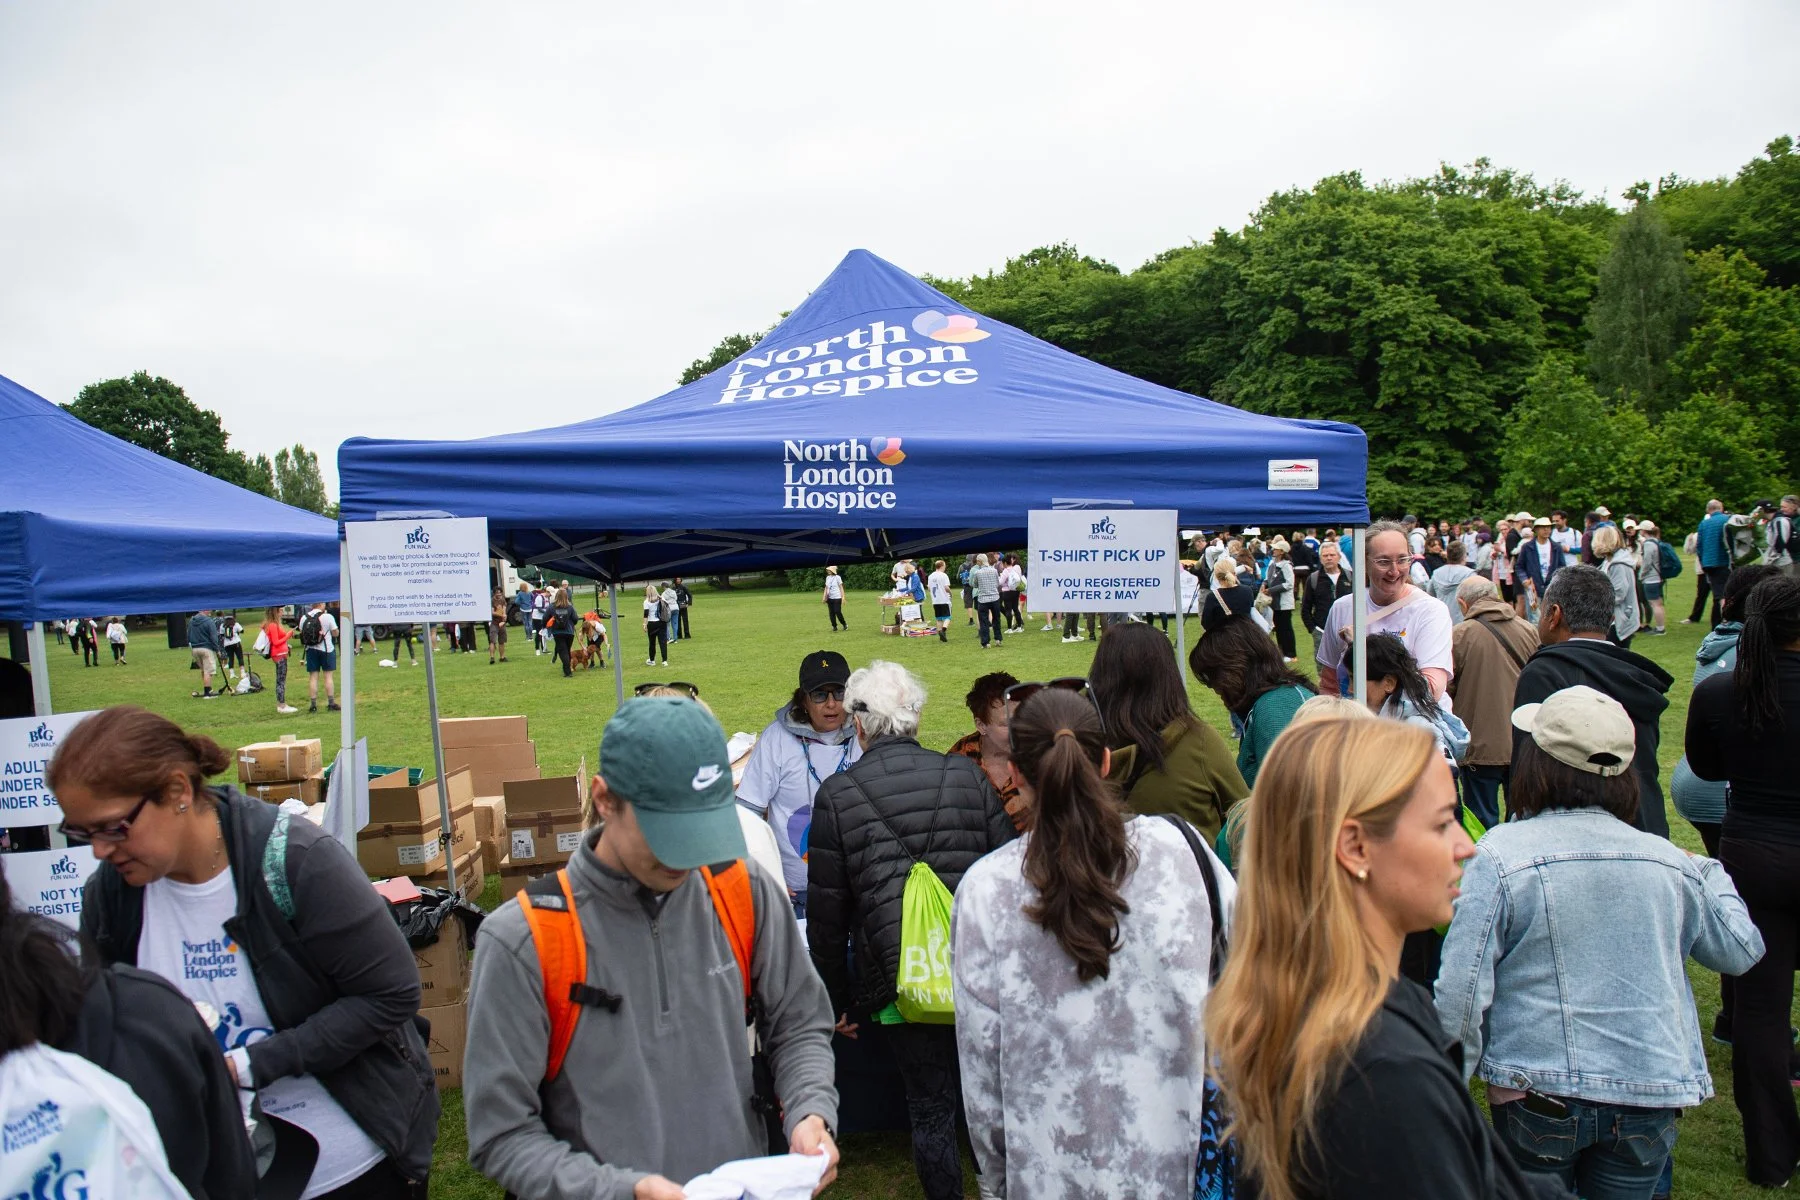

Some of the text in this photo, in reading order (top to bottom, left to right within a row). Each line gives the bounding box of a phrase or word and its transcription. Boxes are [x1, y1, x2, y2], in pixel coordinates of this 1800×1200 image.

[730, 321, 909, 375] North
[722, 345, 970, 391] London
[713, 367, 978, 405] Hospice
[784, 438, 868, 462] North
[783, 462, 894, 486] London
[783, 485, 896, 514] Hospice
[1039, 550, 1166, 562] T-SHIRT PICK UP
[1042, 578, 1160, 587] IF YOU REGISTERED
[1062, 590, 1140, 600] AFTER 2 MAY
[41, 889, 66, 901] NOT
[28, 902, 81, 916] REGISTE
[182, 939, 222, 954] North
[184, 953, 235, 966] London
[184, 965, 237, 982] Hospice
[422, 981, 434, 990] INA
